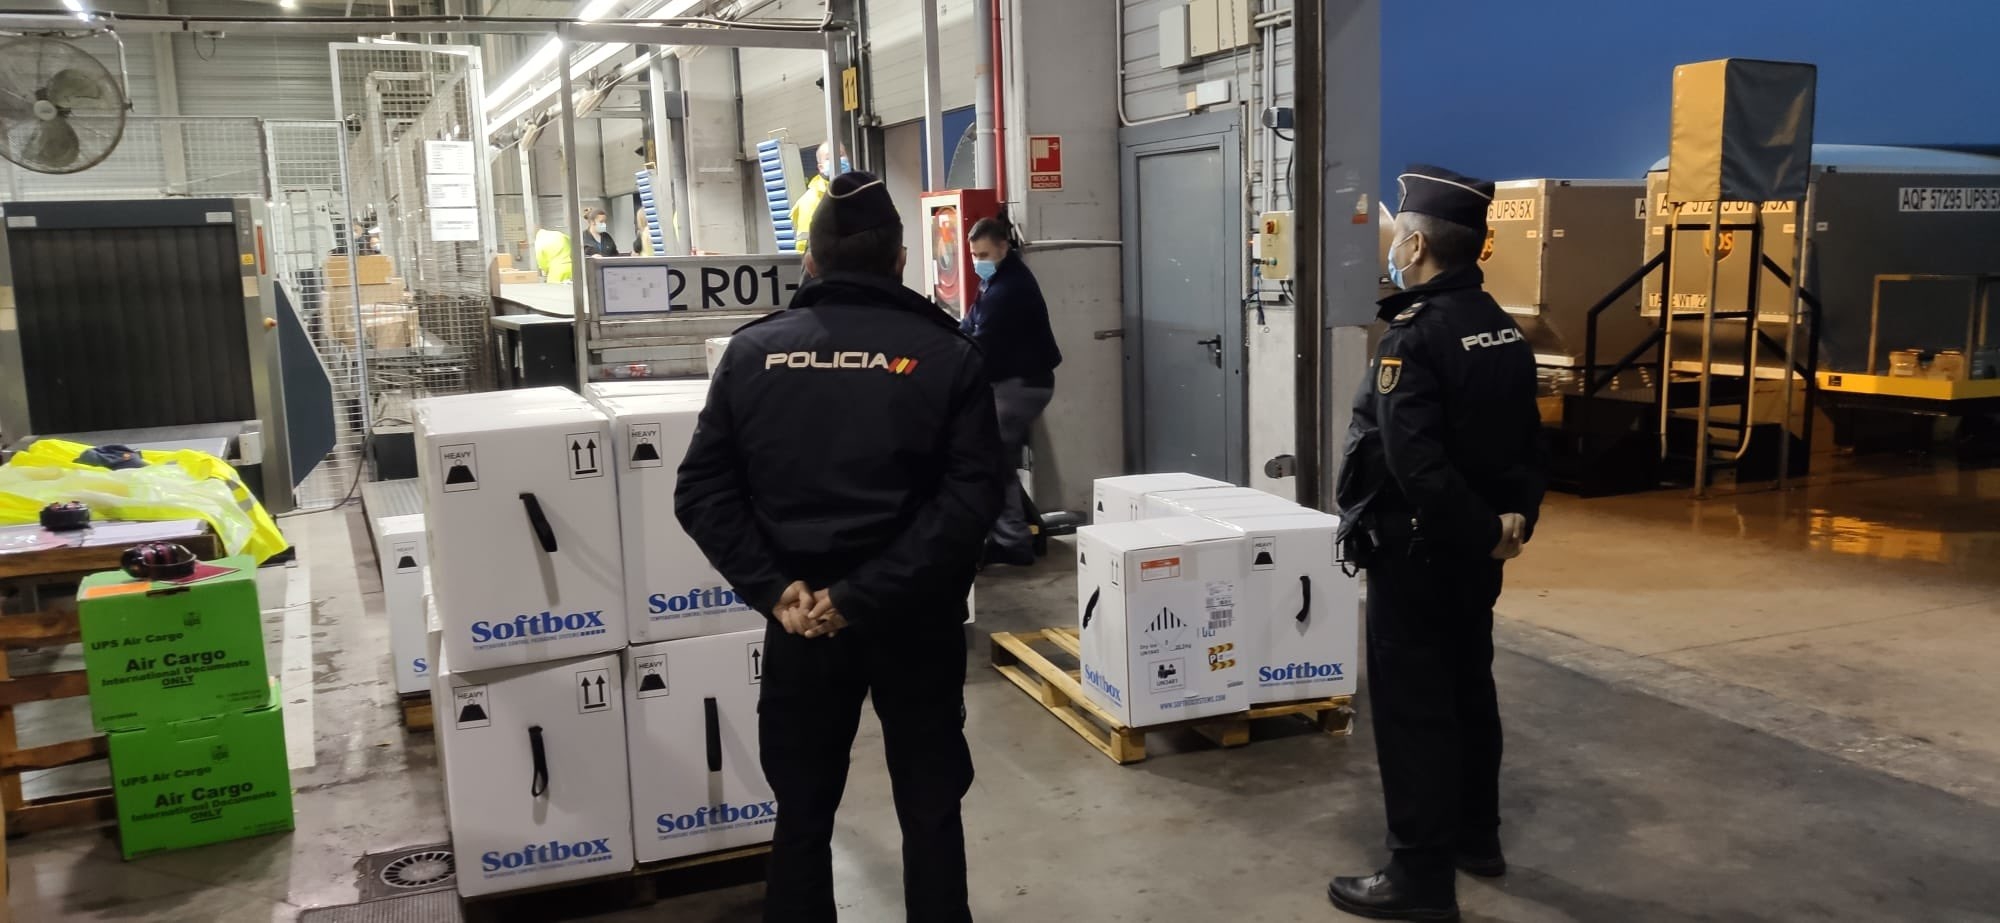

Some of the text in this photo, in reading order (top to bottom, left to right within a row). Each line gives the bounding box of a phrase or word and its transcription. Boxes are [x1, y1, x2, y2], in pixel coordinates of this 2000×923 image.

[1903, 189, 1927, 209] AQF
[1930, 189, 1961, 209] 57295
[1497, 201, 1532, 219] UPS/5X
[765, 351, 889, 370] POLICIA
[648, 586, 745, 614] Softb
[471, 610, 605, 643] Softbox
[91, 632, 184, 650] UPS Air Cargo
[126, 649, 226, 673] Air Cargo
[638, 661, 664, 669] HEAVY
[102, 660, 250, 686] International Documents
[162, 675, 194, 687] ONLY
[1085, 663, 1121, 702] Softbox
[1259, 662, 1344, 682] Softbox
[457, 690, 484, 699] HEAVY
[121, 766, 212, 787] UPS Air Cargo
[155, 782, 254, 808] Air Cargo
[131, 790, 277, 822] International Documents
[190, 808, 223, 821] ONLY
[656, 801, 776, 834] Softbox
[481, 837, 612, 872] Softbox
